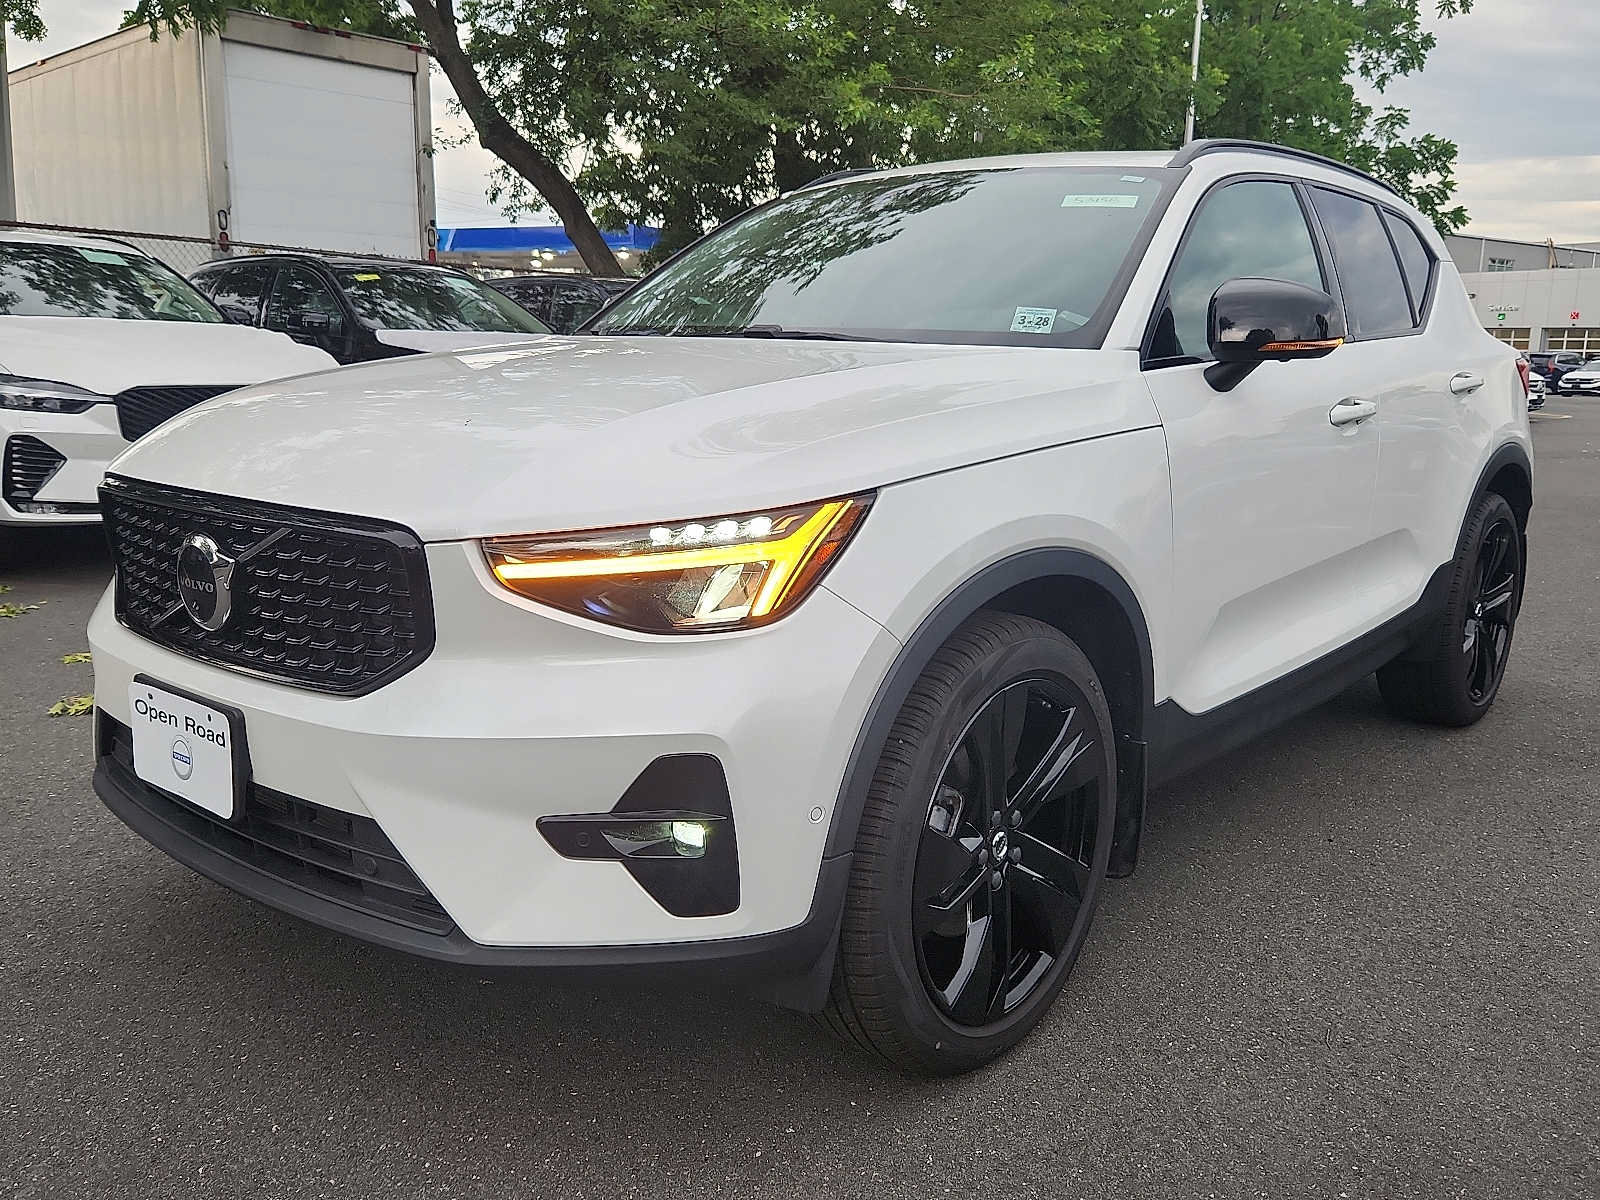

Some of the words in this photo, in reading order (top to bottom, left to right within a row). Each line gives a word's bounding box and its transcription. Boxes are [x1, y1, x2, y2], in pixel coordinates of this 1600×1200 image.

[181, 576, 214, 593] VOLVO
[134, 699, 178, 727] Open
[184, 715, 226, 748] Road
